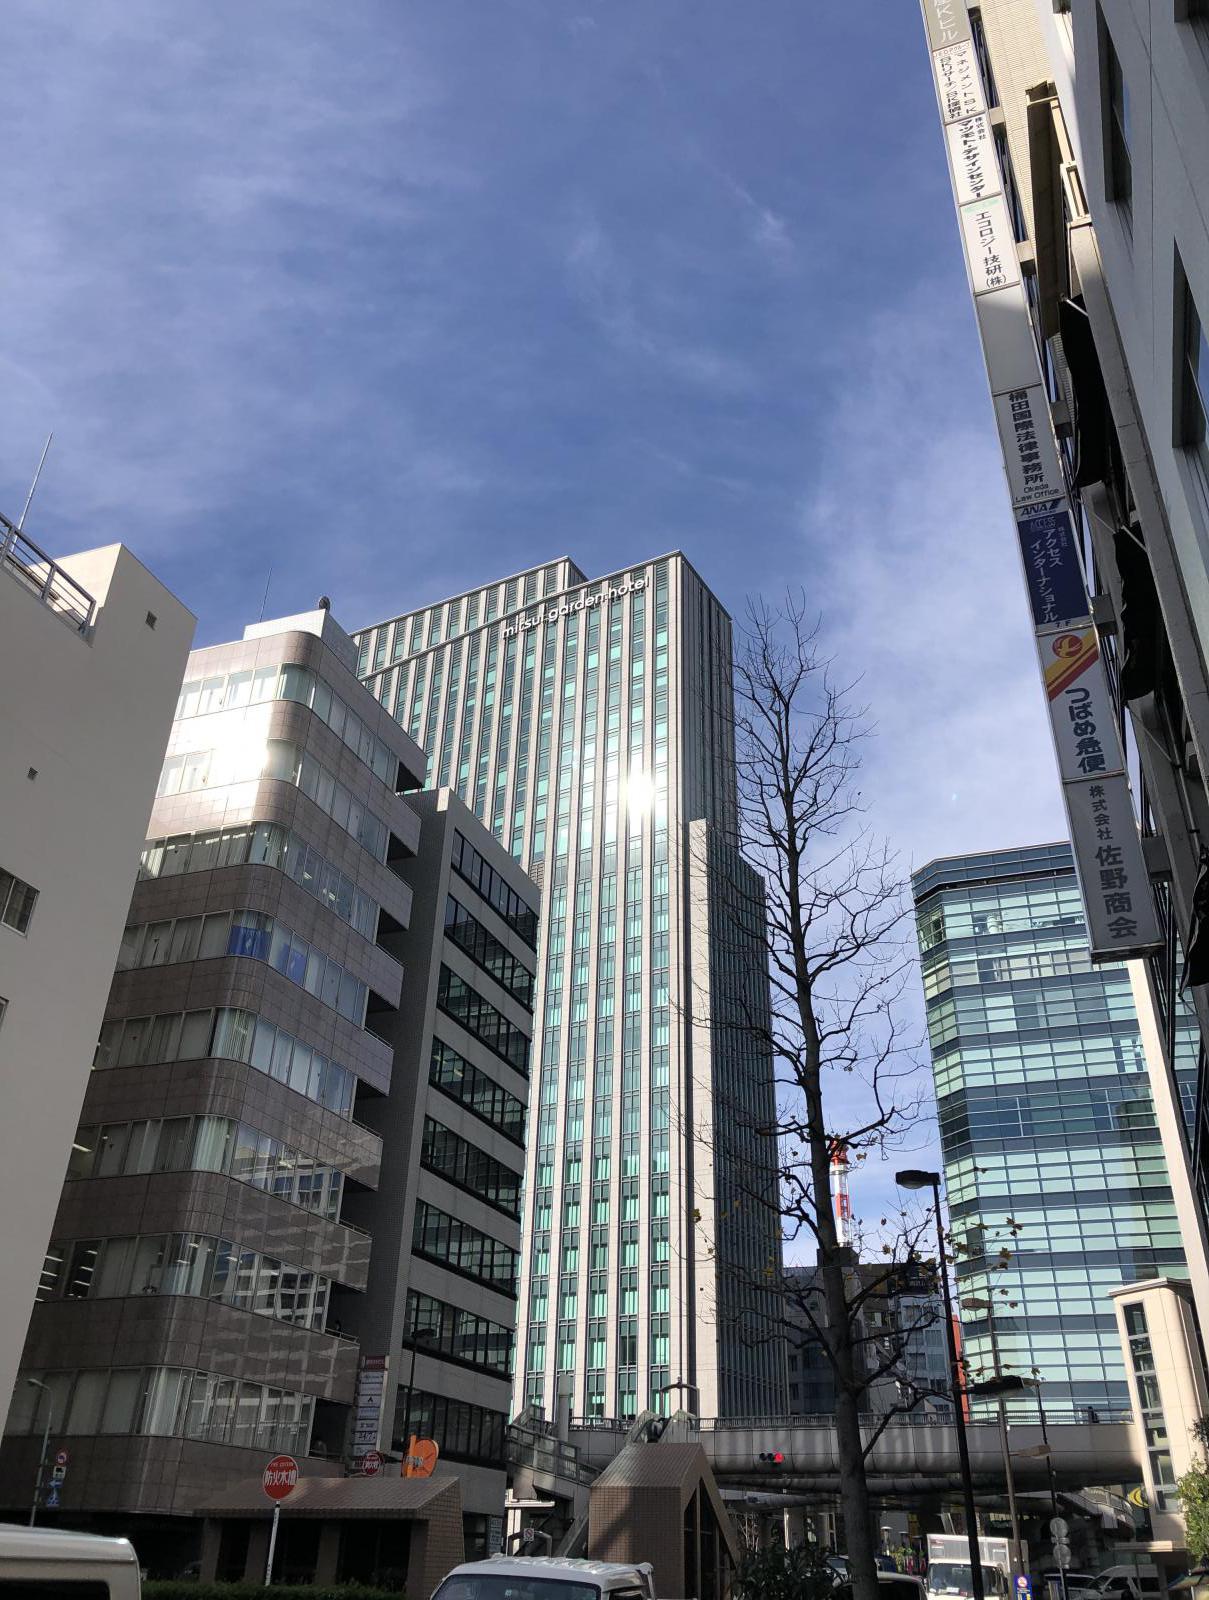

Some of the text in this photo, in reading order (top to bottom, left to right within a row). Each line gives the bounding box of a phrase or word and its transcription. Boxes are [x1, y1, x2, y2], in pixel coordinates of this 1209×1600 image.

[1015, 488, 1060, 503] Law Office
[1020, 504, 1048, 516] ANA
[1043, 528, 1064, 568] アクセス
[502, 576, 650, 640] mitsui garden hotel
[1031, 540, 1058, 623] インターナショナル
[1065, 687, 1107, 774] つばめ急便
[1089, 785, 1138, 939] 株式会社 佐野商会
